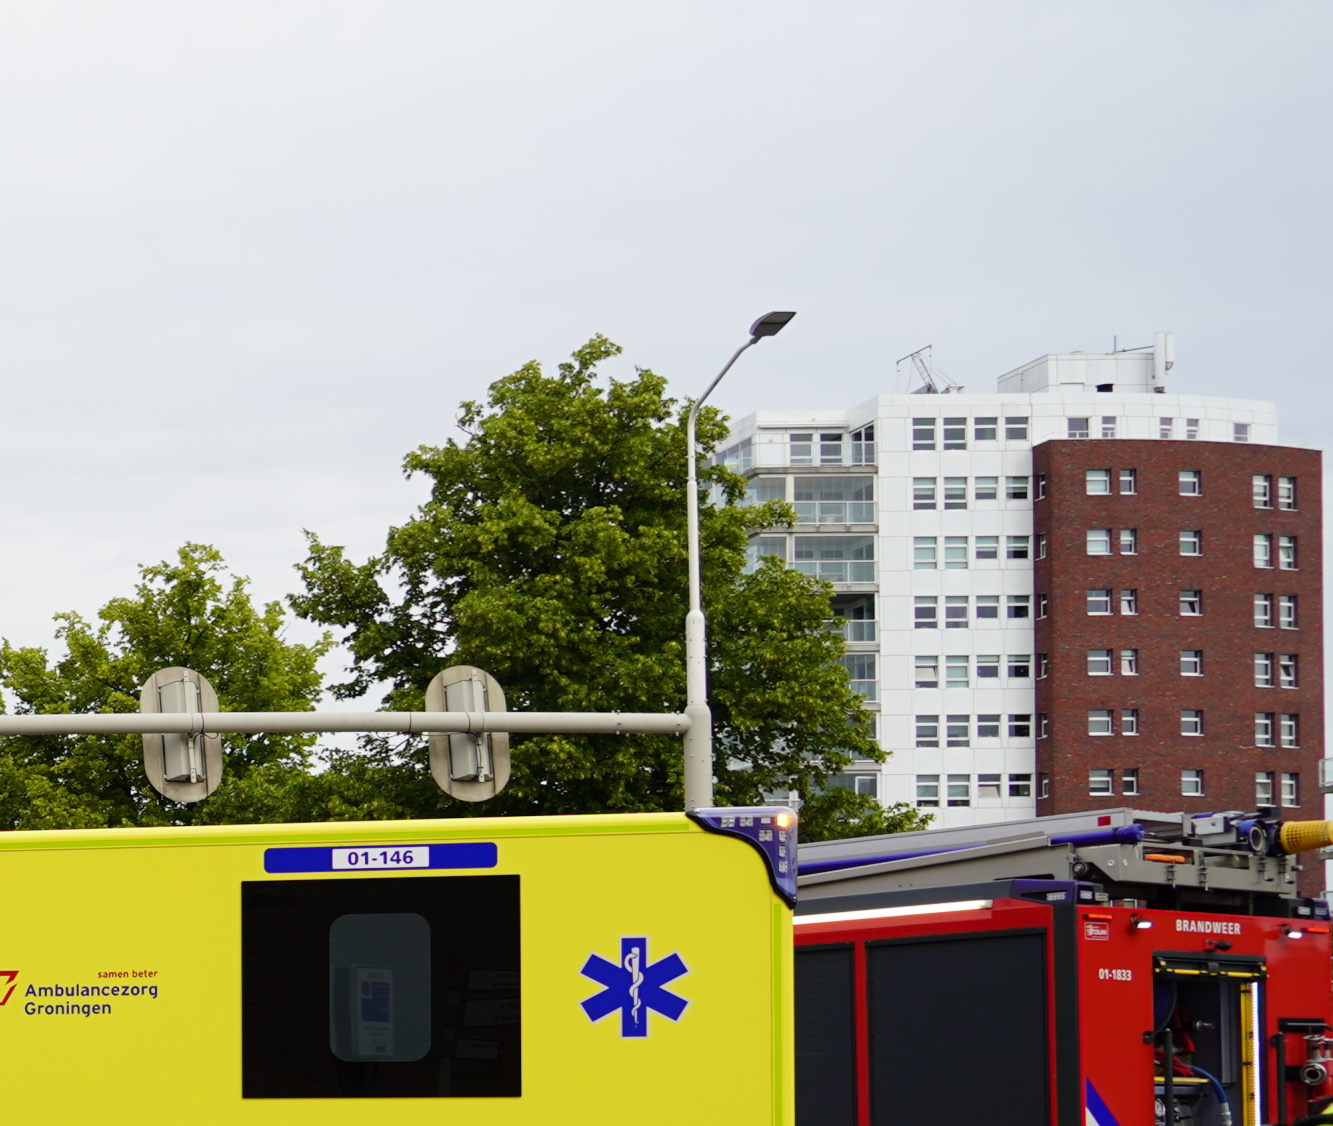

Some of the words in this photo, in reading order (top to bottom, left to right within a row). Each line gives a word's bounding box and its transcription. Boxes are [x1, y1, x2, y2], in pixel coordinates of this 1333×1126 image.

[347, 850, 414, 866] 01-146
[1175, 919, 1242, 935] BRANDWEER
[97, 971, 129, 979] samen
[132, 969, 158, 978] beter
[1098, 968, 1132, 981] 01-1833
[24, 984, 158, 999] Ambulancezorg
[24, 1001, 112, 1018] Groningen
